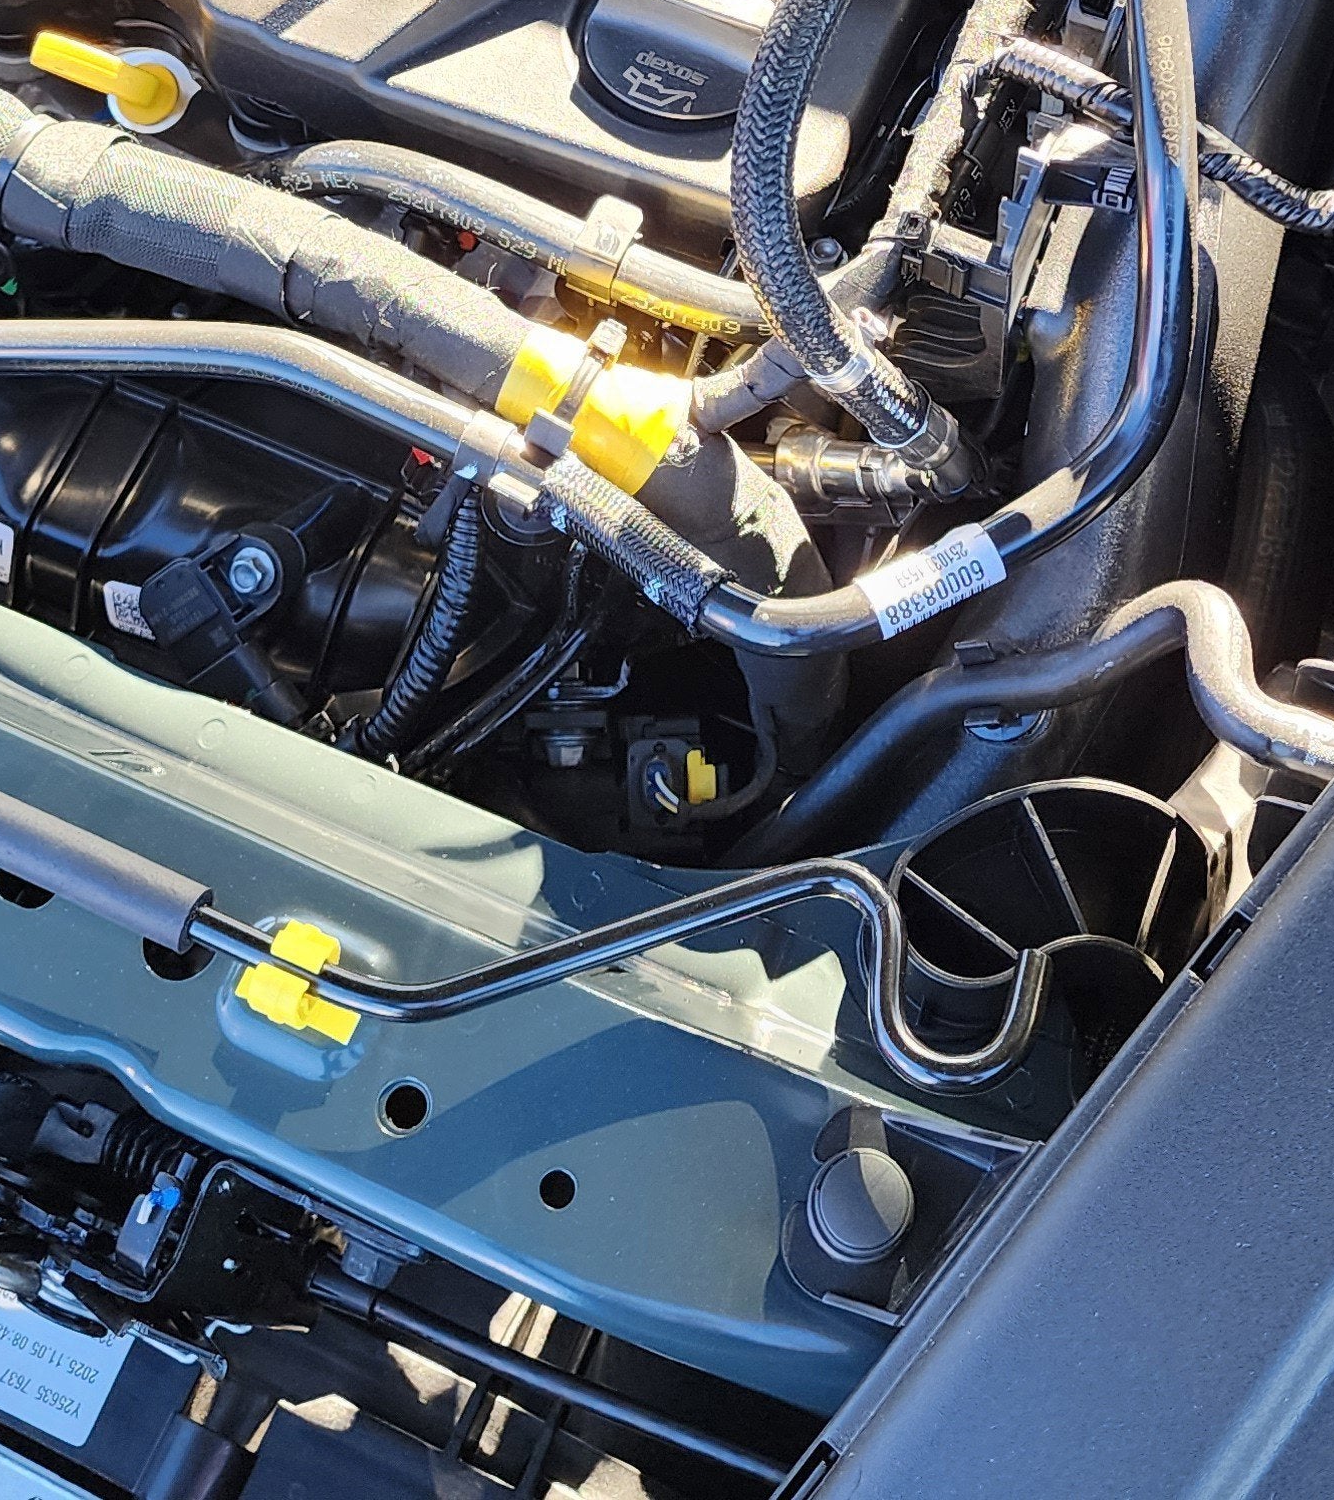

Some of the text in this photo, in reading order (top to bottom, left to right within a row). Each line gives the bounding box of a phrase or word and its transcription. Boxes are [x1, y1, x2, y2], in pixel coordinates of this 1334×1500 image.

[636, 49, 708, 86] dexos
[884, 559, 986, 626] 60008388
[30, 1340, 99, 1384] 2025.11.05
[0, 1368, 32, 1395] 7637
[34, 1383, 83, 1419] Y25635
